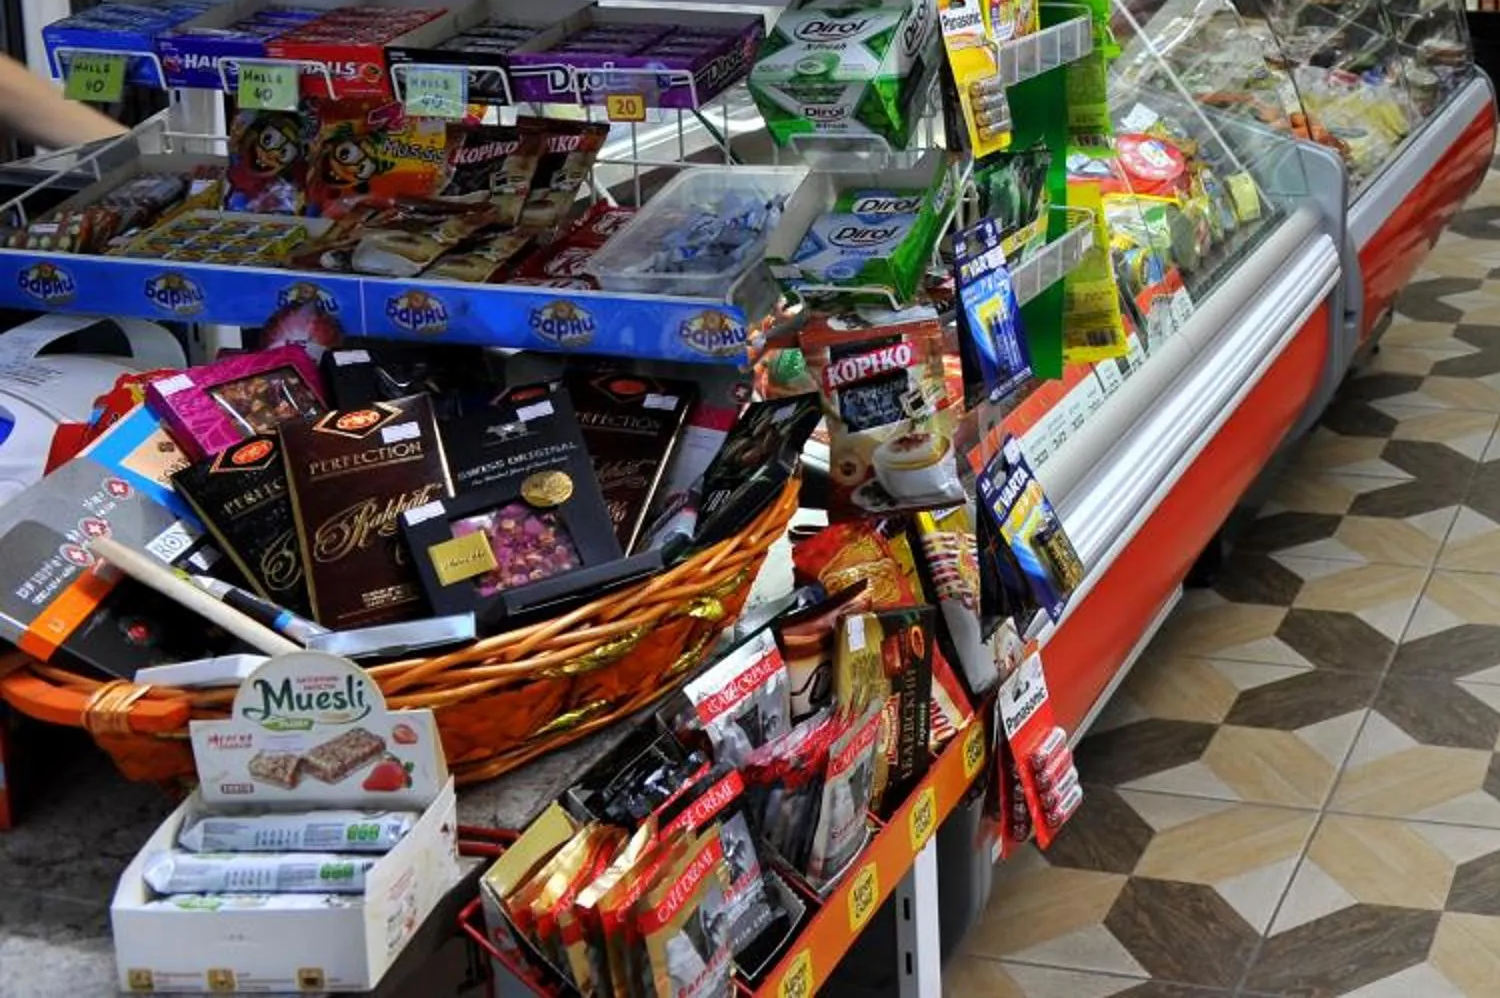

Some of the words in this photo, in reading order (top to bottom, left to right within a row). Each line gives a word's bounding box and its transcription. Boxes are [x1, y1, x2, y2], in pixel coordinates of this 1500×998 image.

[799, 19, 867, 35] Dirol
[616, 100, 637, 116] 20
[803, 105, 845, 119] Dirol
[454, 141, 520, 165] KOPIKO
[547, 134, 580, 152] IKO
[856, 196, 920, 214] Dirol
[832, 224, 900, 242] Dirol
[529, 308, 596, 342] Барни
[678, 318, 747, 354] Барни
[826, 341, 913, 387] KOPIKO
[308, 442, 422, 477] PERFECTION
[222, 475, 286, 516] PERFEC
[1001, 466, 1030, 508] VARTA
[242, 674, 371, 724] Muesli
